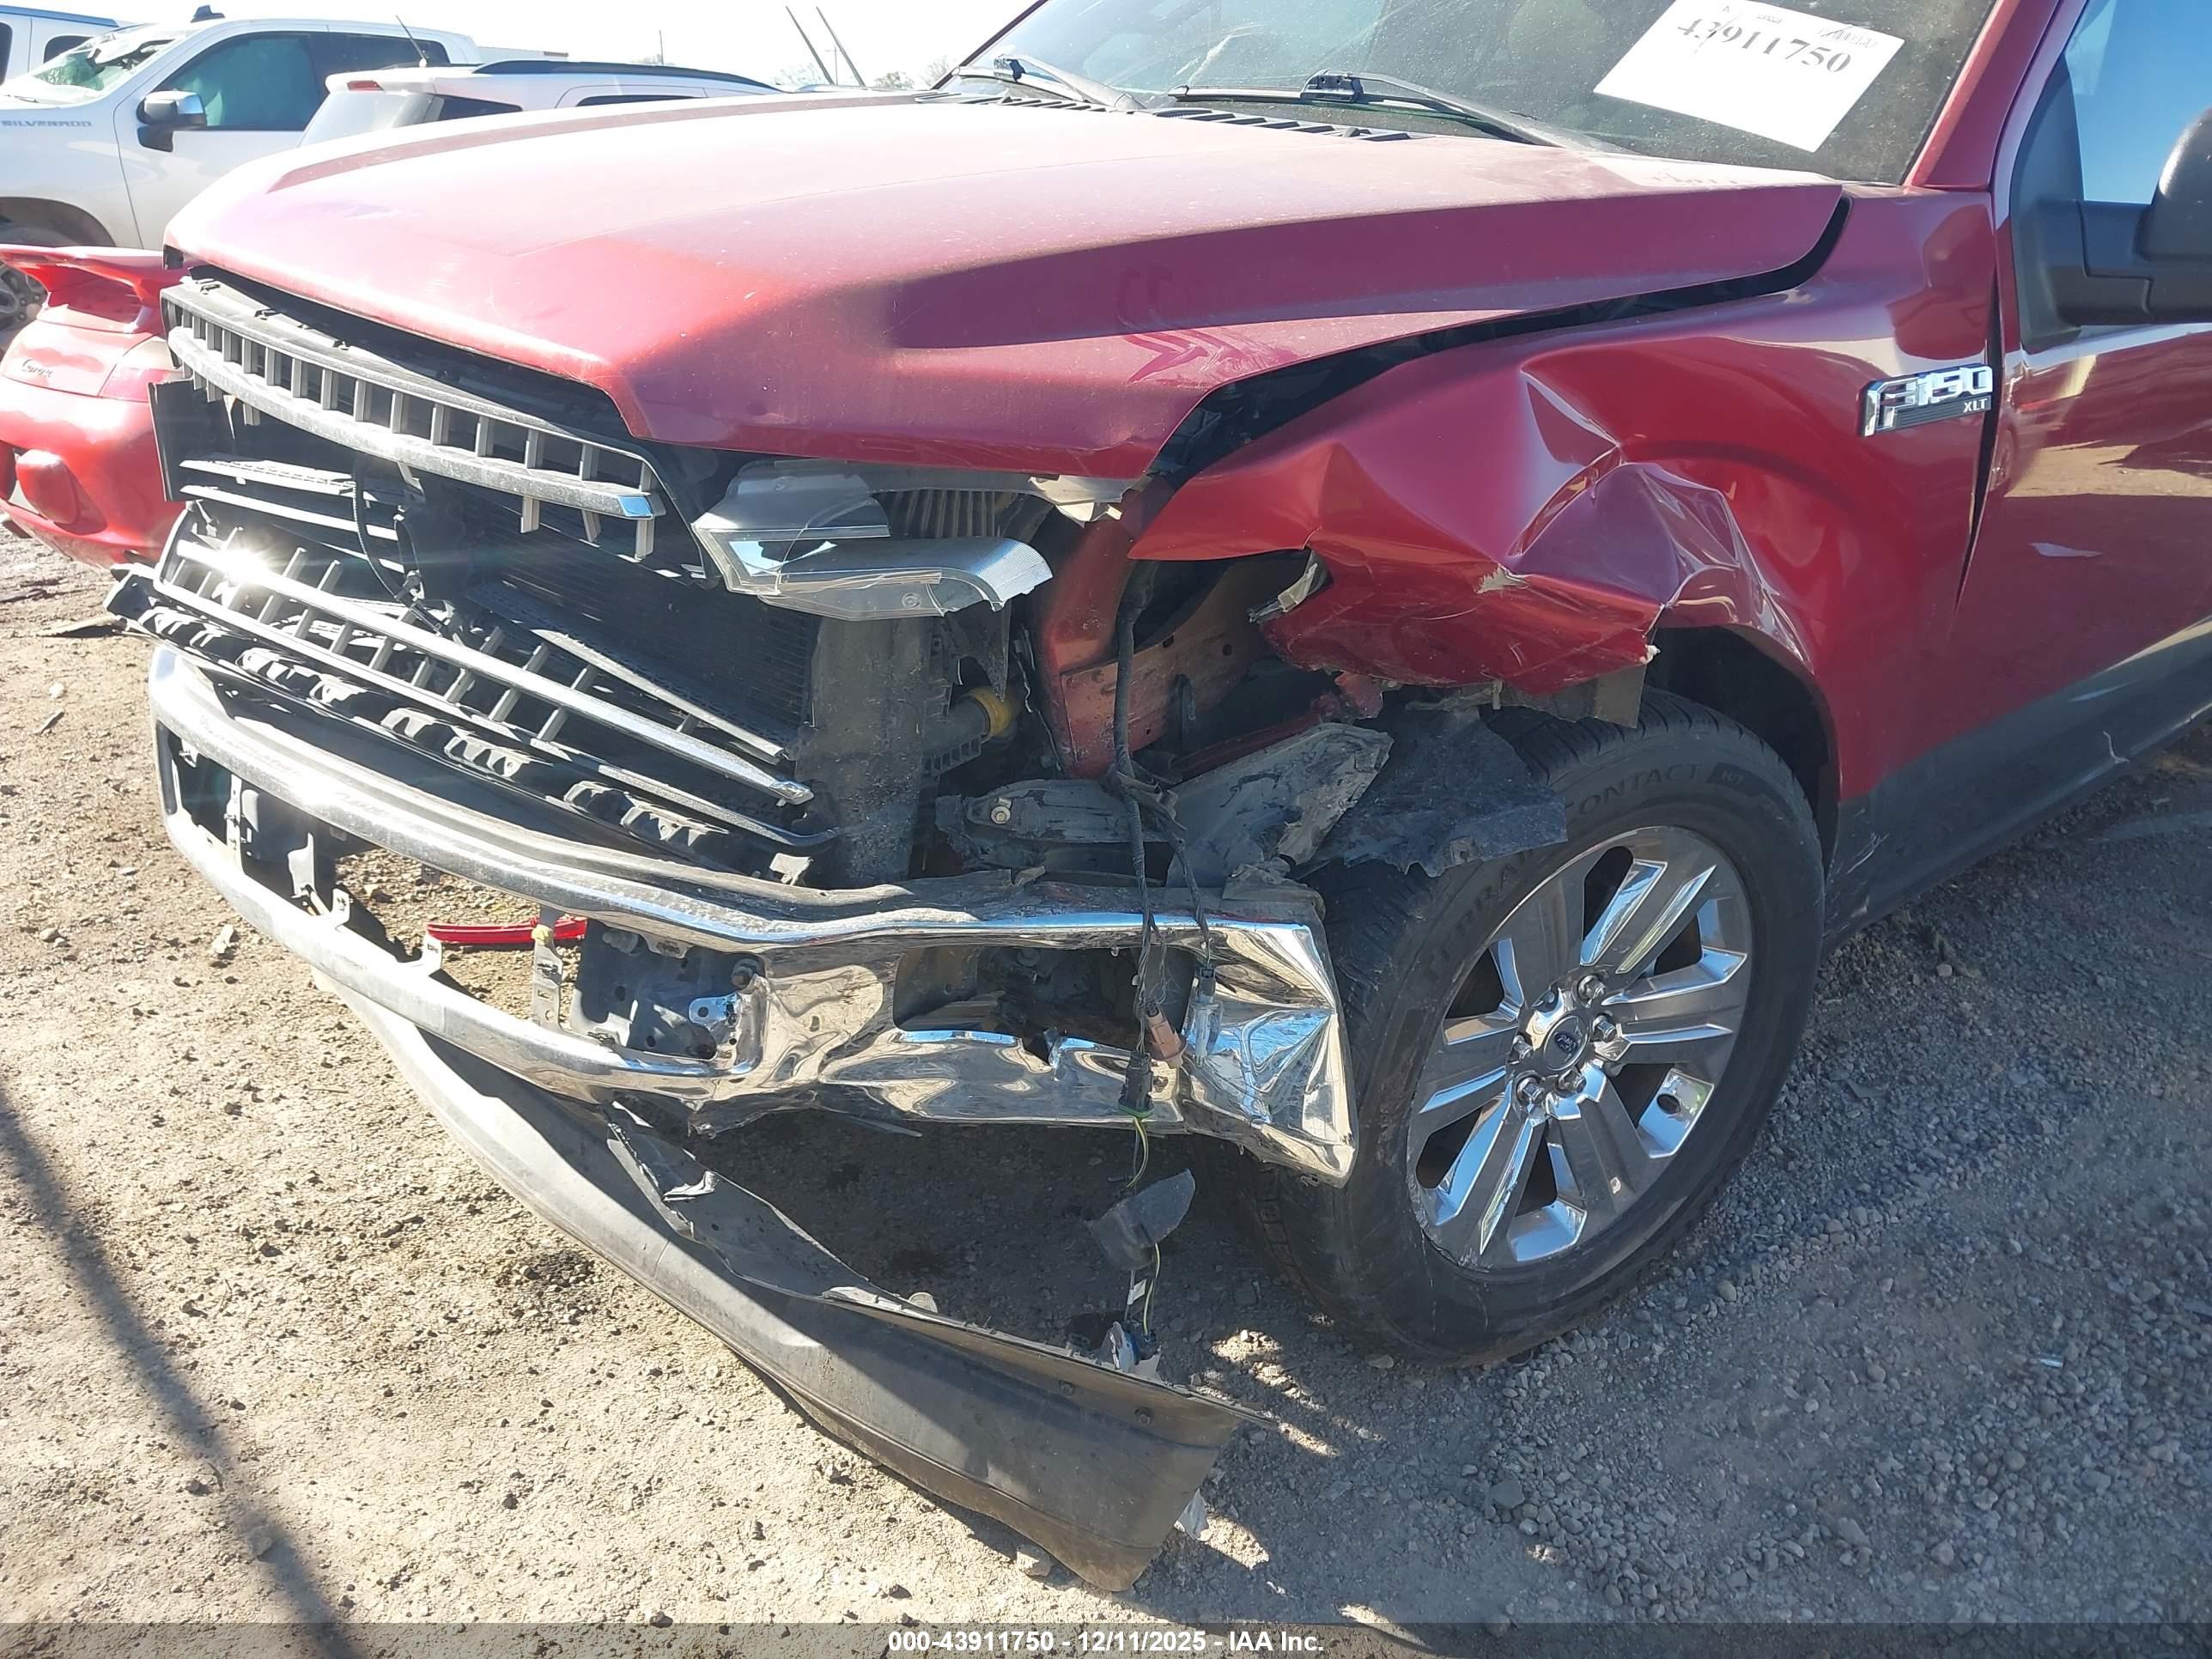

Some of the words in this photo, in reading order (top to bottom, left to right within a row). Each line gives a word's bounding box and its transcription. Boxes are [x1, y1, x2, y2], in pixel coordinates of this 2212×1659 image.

[1677, 17, 1851, 73] 43911750
[1963, 398, 1988, 413] XLT
[1565, 762, 1703, 815] ONTACT
